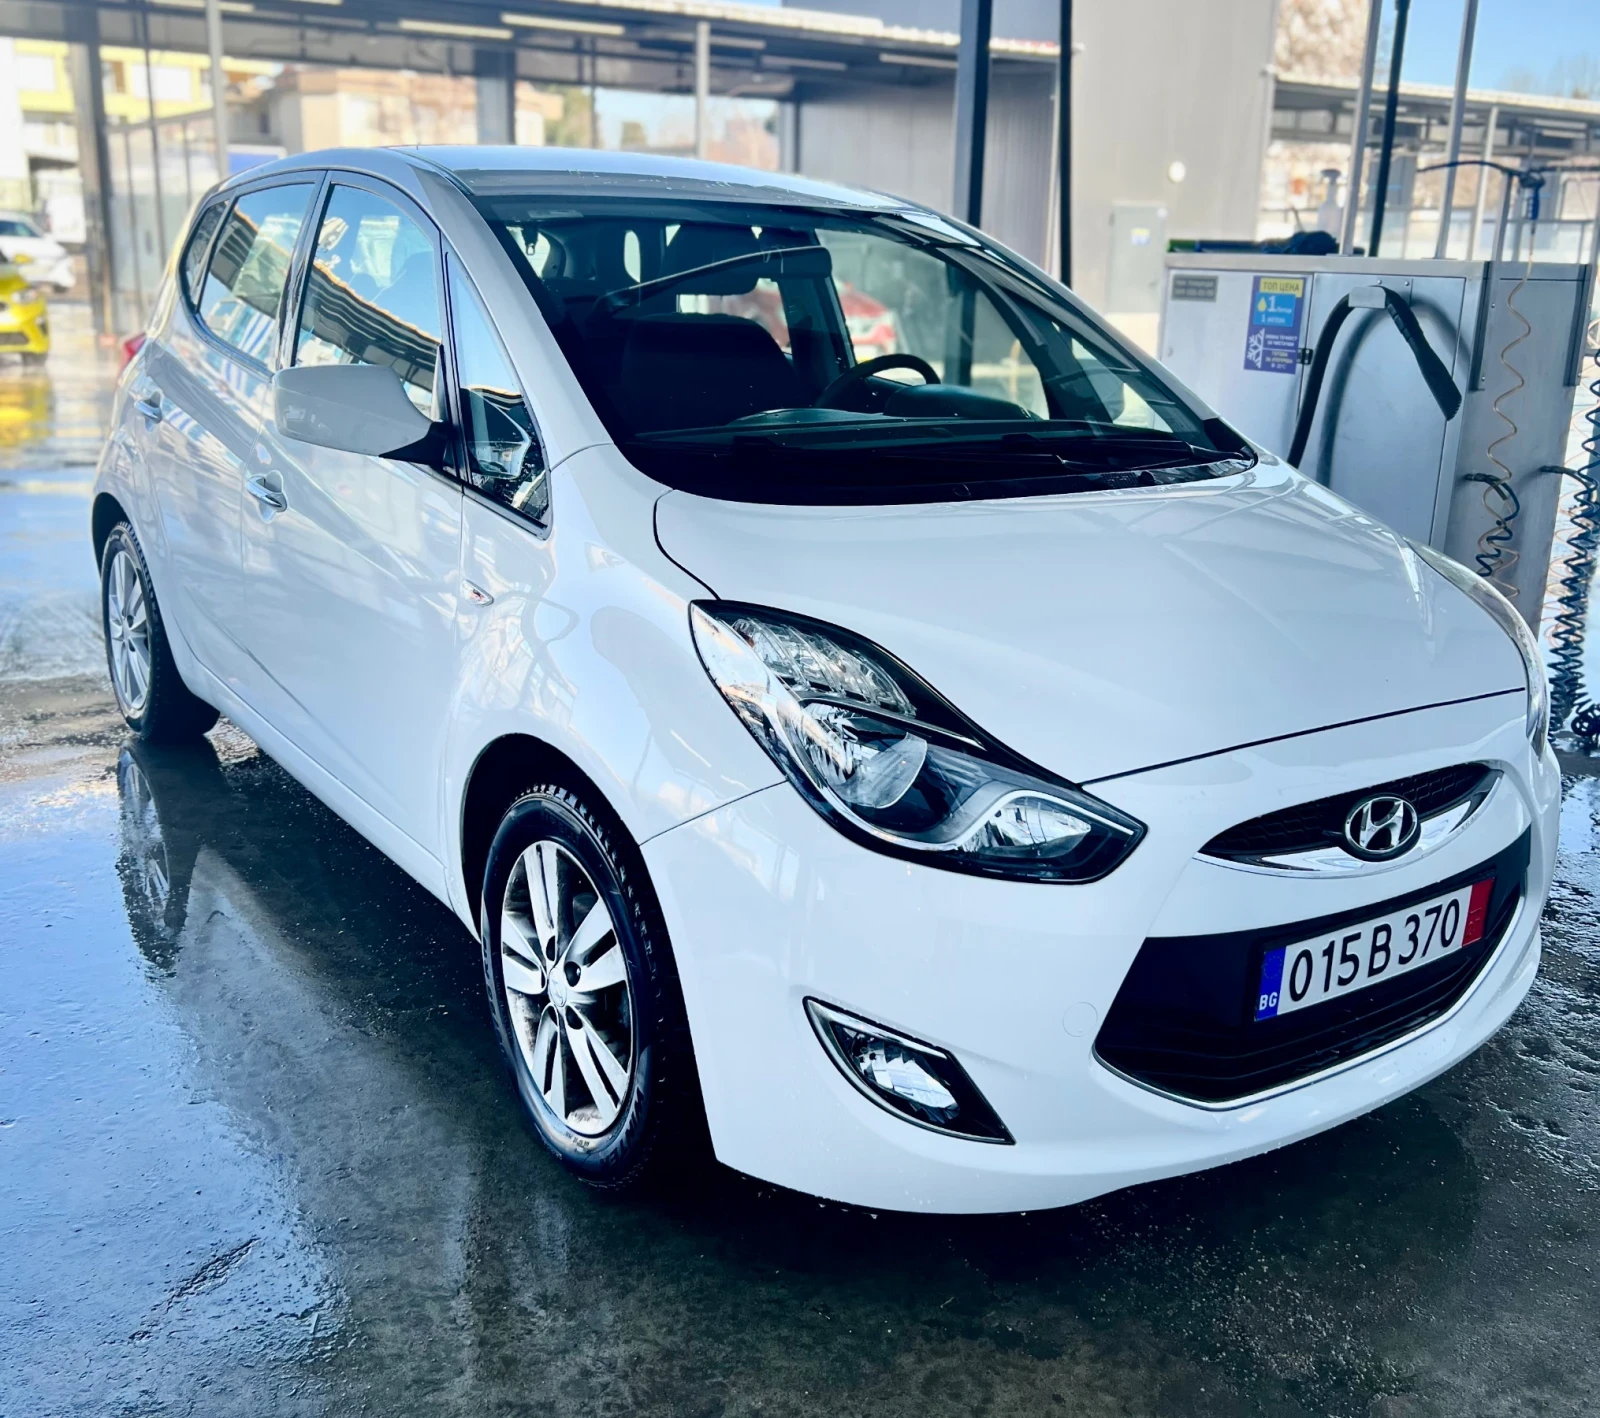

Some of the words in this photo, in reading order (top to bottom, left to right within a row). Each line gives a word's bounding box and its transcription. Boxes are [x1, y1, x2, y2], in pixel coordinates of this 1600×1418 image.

[1263, 281, 1278, 291] ТОП
[1279, 282, 1300, 292] ЦЕНА
[1267, 295, 1277, 313] 1
[1258, 991, 1279, 1011] BG
